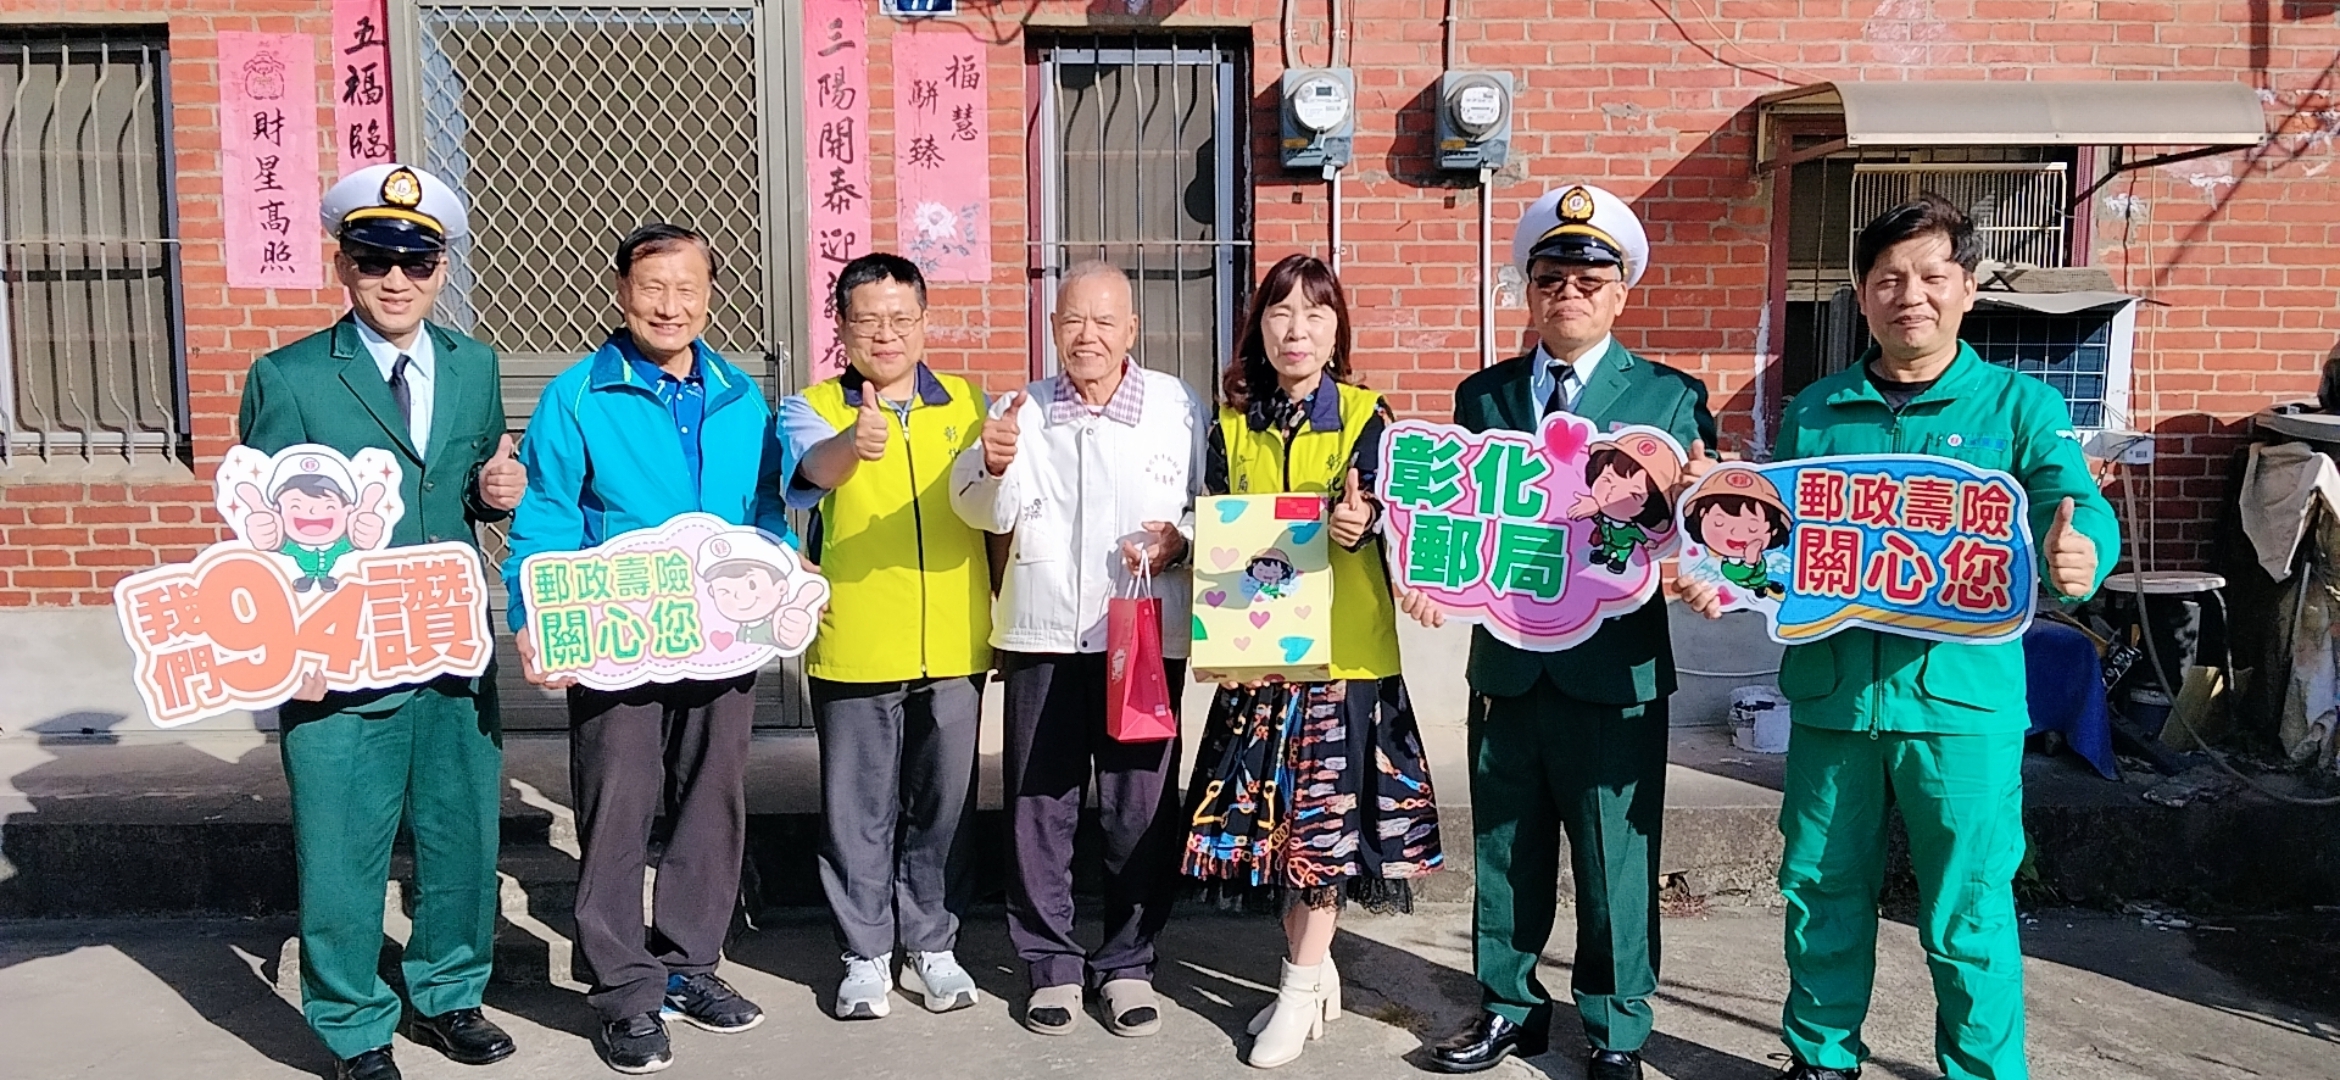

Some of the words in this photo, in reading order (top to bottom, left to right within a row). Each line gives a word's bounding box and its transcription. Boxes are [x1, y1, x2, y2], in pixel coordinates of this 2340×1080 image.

[342, 15, 389, 160] 五福臨
[945, 54, 981, 142] 福慧
[252, 107, 296, 275] 財星高照
[817, 17, 863, 369] 三陽開泰迎
[1388, 434, 1547, 518] 彰化
[1798, 471, 2011, 538] 郵政壽險
[534, 552, 693, 605] 郵政壽險
[1409, 513, 1567, 600] 郵局
[1798, 527, 2009, 611] 關心您
[540, 600, 700, 670] 關心您
